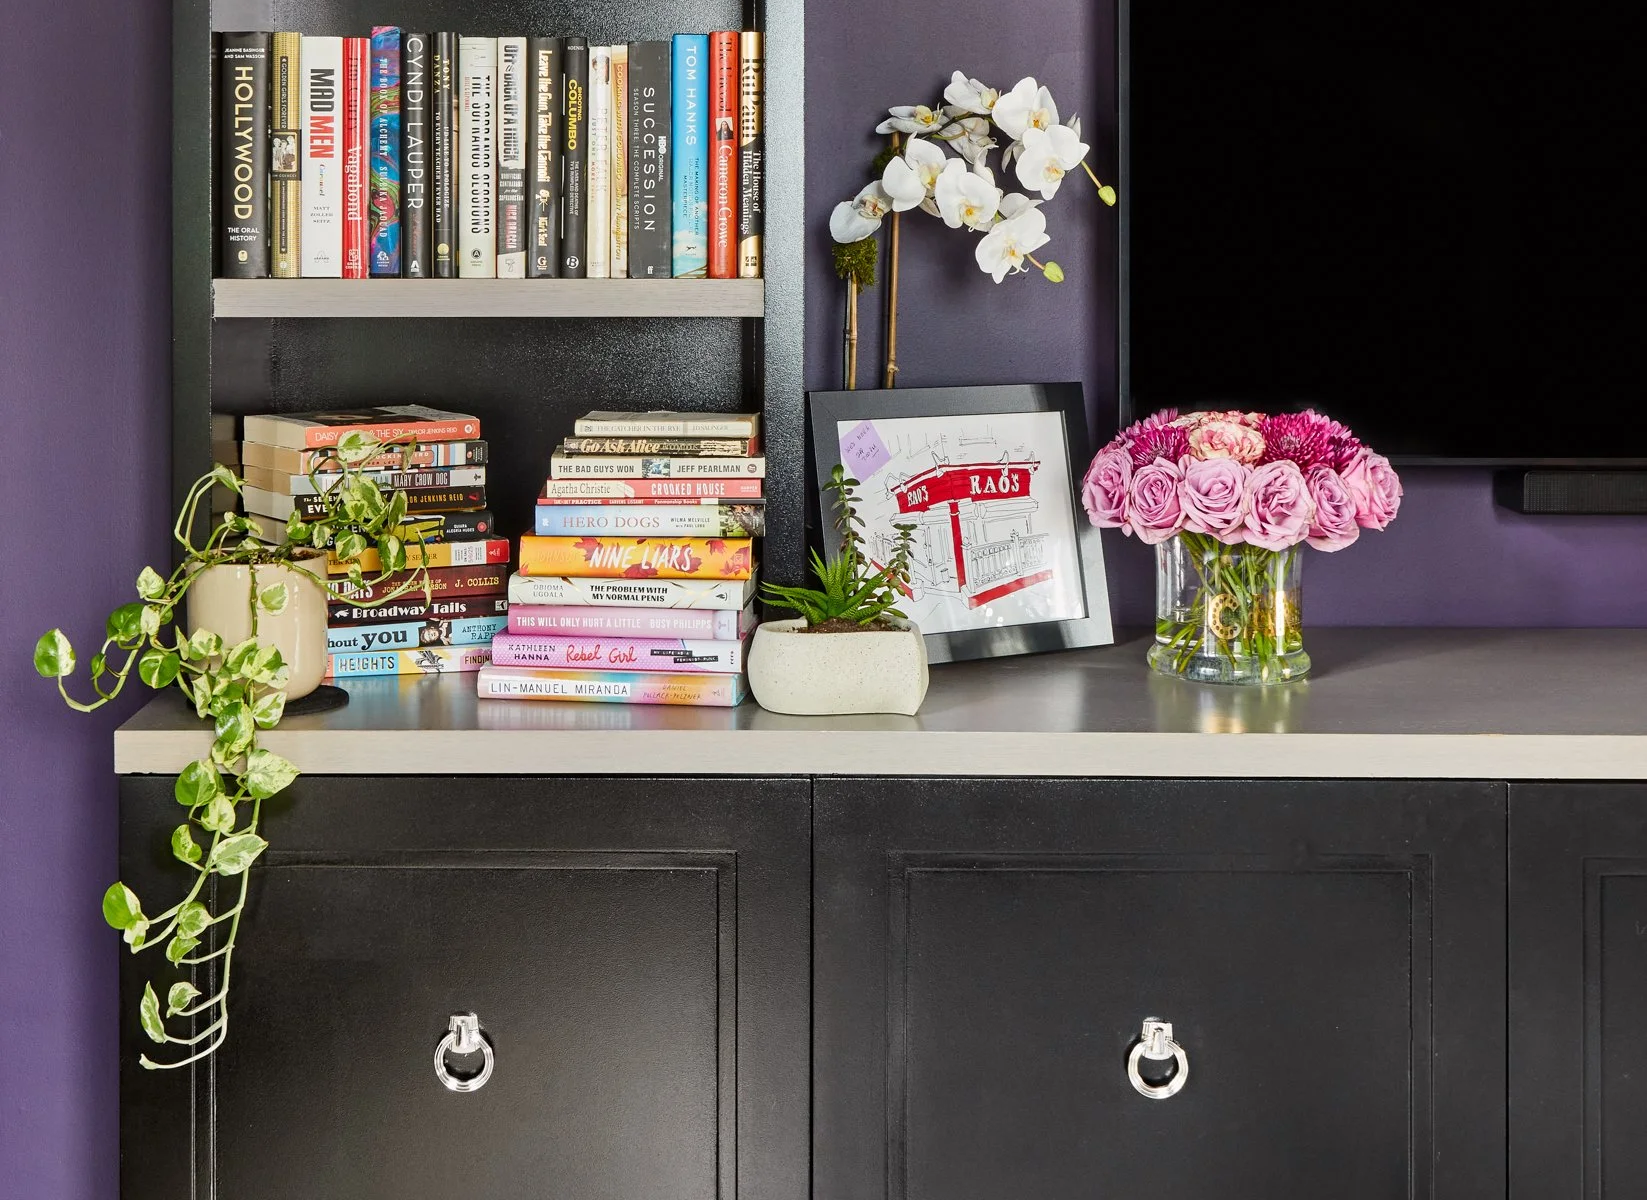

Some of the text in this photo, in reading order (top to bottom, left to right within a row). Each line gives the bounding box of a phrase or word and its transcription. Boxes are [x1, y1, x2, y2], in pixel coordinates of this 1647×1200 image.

[686, 46, 696, 146] TOM HANKS
[310, 68, 335, 159] MAD MEN
[569, 79, 577, 150] COLUMBO
[234, 66, 254, 220] HOLLYWOOD
[658, 136, 666, 154] HBO
[643, 87, 655, 231] SUCCESSION
[345, 145, 362, 221] Vagabond
[742, 150, 752, 235] Hidden Meanings
[752, 151, 761, 213] The House of
[580, 439, 600, 453] Go
[601, 439, 625, 453] Ask
[626, 438, 660, 453] Alice
[558, 464, 741, 473] THE BAD GUYS WON JEFF PEARLMAN
[551, 482, 725, 497] Agatha Christie CROOKED HOUSE
[969, 473, 1020, 495] RAO'S
[908, 484, 929, 507] RAO'S
[562, 516, 660, 528] HERO DOGS
[352, 602, 467, 619] Broadway Tails
[517, 616, 712, 630] THIS WILL ONLY HURT A LITTLE BUSY PHILIPPS
[514, 653, 550, 661] HANNA
[566, 644, 638, 664] Rebel Girl
[491, 683, 627, 696] LIN-MANUEL MIRANDA
